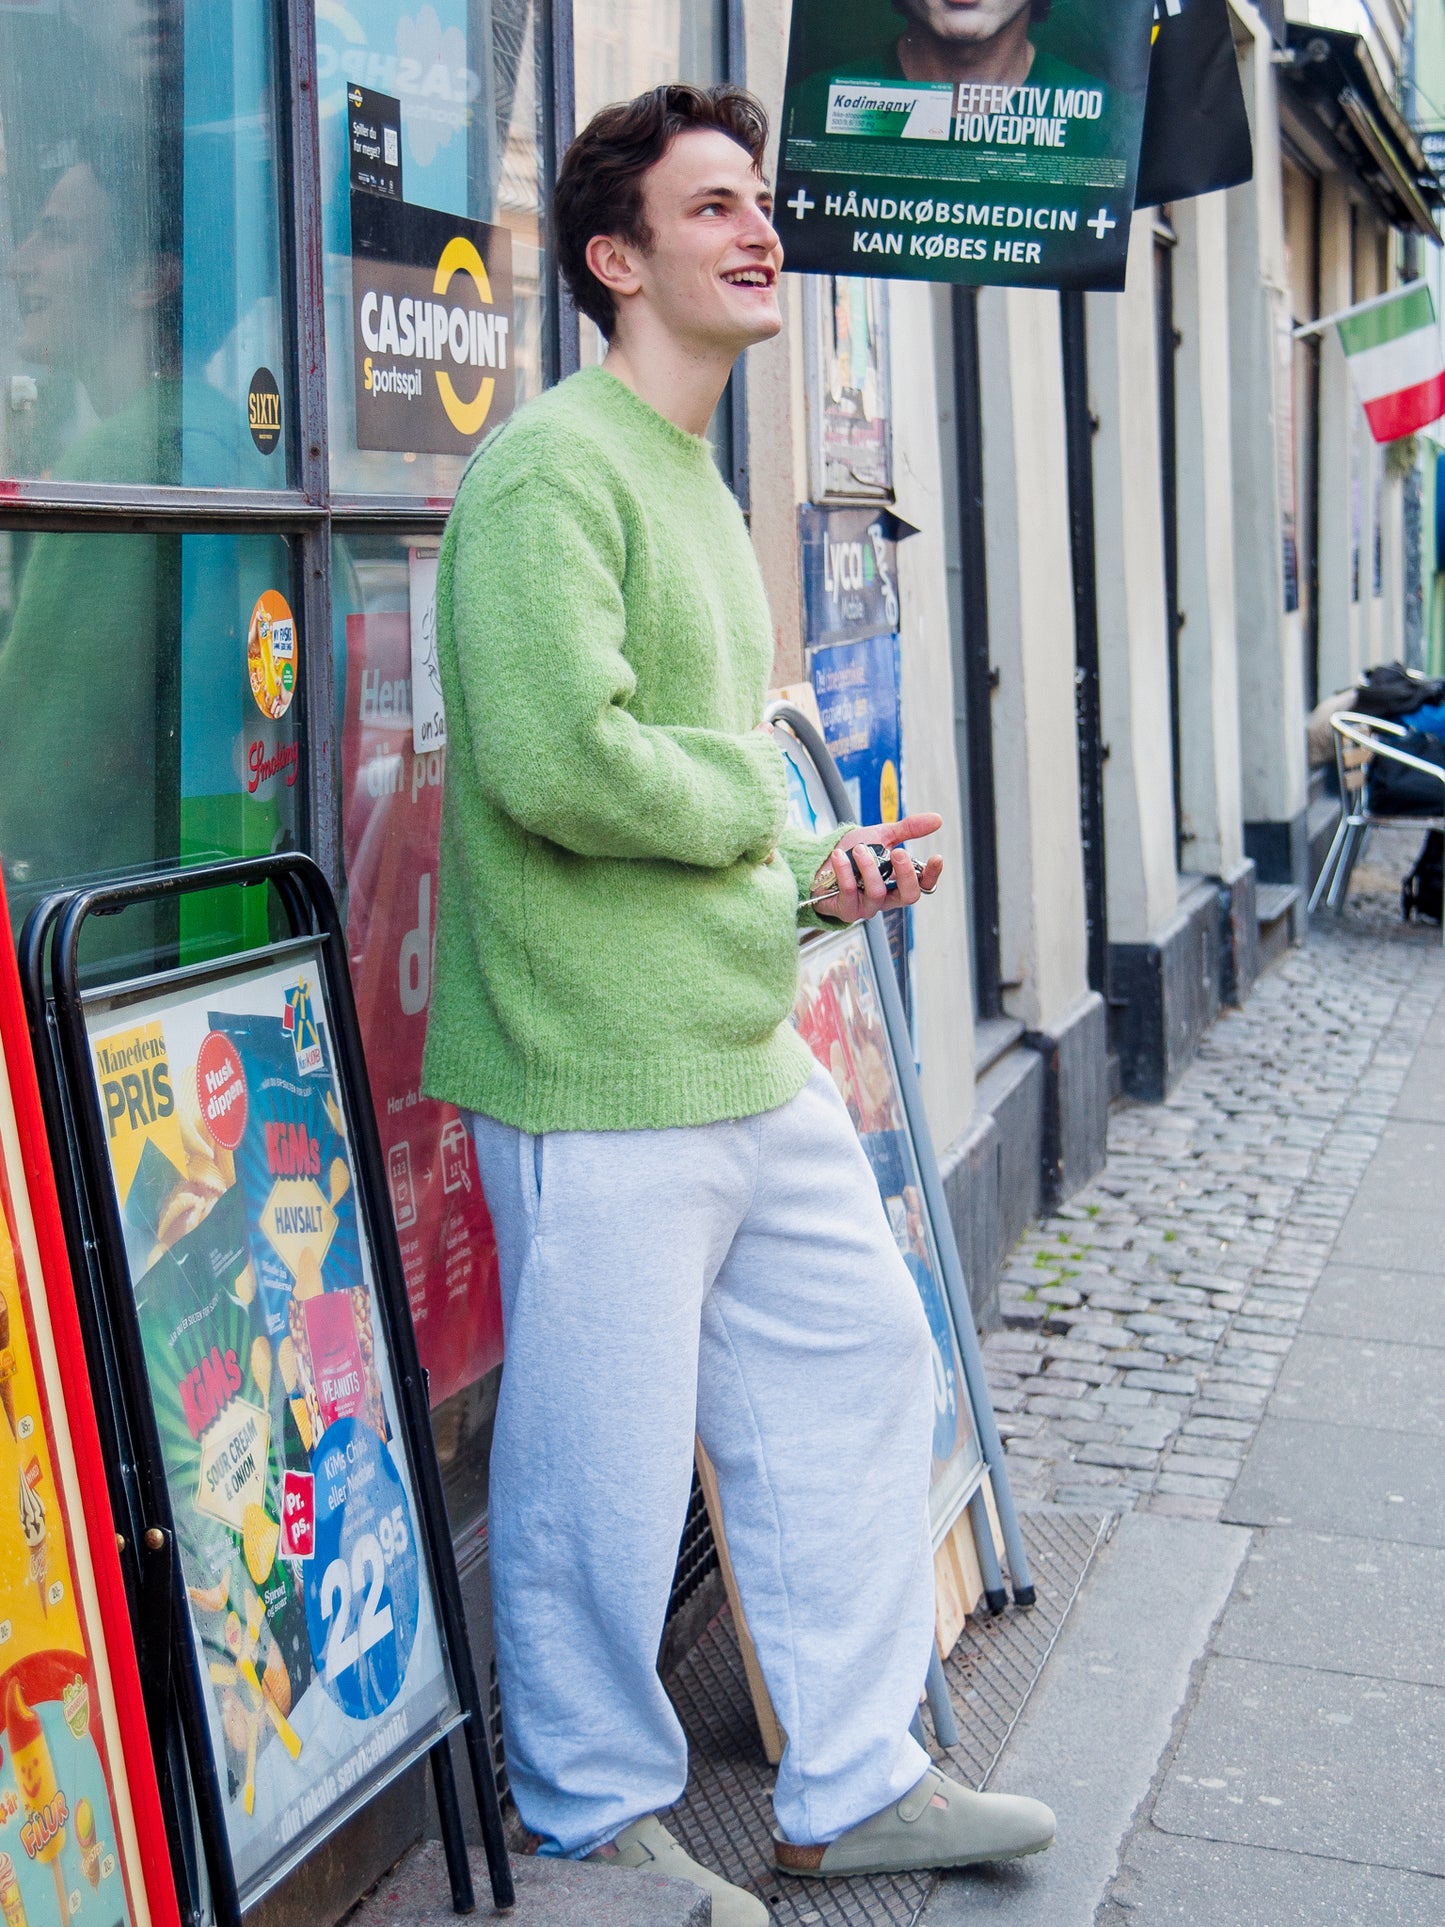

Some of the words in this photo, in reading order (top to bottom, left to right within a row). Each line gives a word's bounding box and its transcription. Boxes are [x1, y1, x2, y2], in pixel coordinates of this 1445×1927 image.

[833, 94, 917, 114] Kodimagnyl
[957, 83, 1051, 117] EFFEKTIV
[1053, 88, 1103, 120] MOD
[954, 112, 1068, 148] HOVEDPINE
[824, 190, 1077, 232] HÅNDKØBSMEDICIN
[852, 231, 903, 255] KAN
[909, 234, 987, 260] KØBES
[993, 240, 1041, 264] HER
[360, 291, 509, 370] CASHPOINT
[363, 357, 422, 401] Sportsspil
[249, 392, 279, 424] SIXTY
[823, 531, 863, 603] Lyca
[359, 668, 412, 721] Hen
[248, 739, 299, 793] Smoking
[367, 743, 405, 798] din
[96, 1035, 167, 1077] Månedens
[205, 1057, 234, 1094] Husk
[102, 1062, 175, 1139] PRIS
[207, 1078, 245, 1121] dippen
[265, 1121, 321, 1177] KiMs
[392, 1163, 407, 1178] 123
[274, 1205, 324, 1235] HAVSALT
[179, 1346, 242, 1440] KiMs
[321, 1370, 361, 1404] PEANUTS
[206, 1451, 233, 1493] SOUR
[228, 1416, 258, 1464] CREAM
[323, 1448, 347, 1481] KiMs
[224, 1483, 233, 1501] &
[231, 1452, 256, 1494] ONION
[286, 1491, 305, 1517] Pr.
[328, 1489, 348, 1512] eller
[291, 1517, 310, 1545] ps.
[320, 1533, 394, 1684] 22
[378, 1505, 409, 1565] 95
[301, 1775, 338, 1825] lokale
